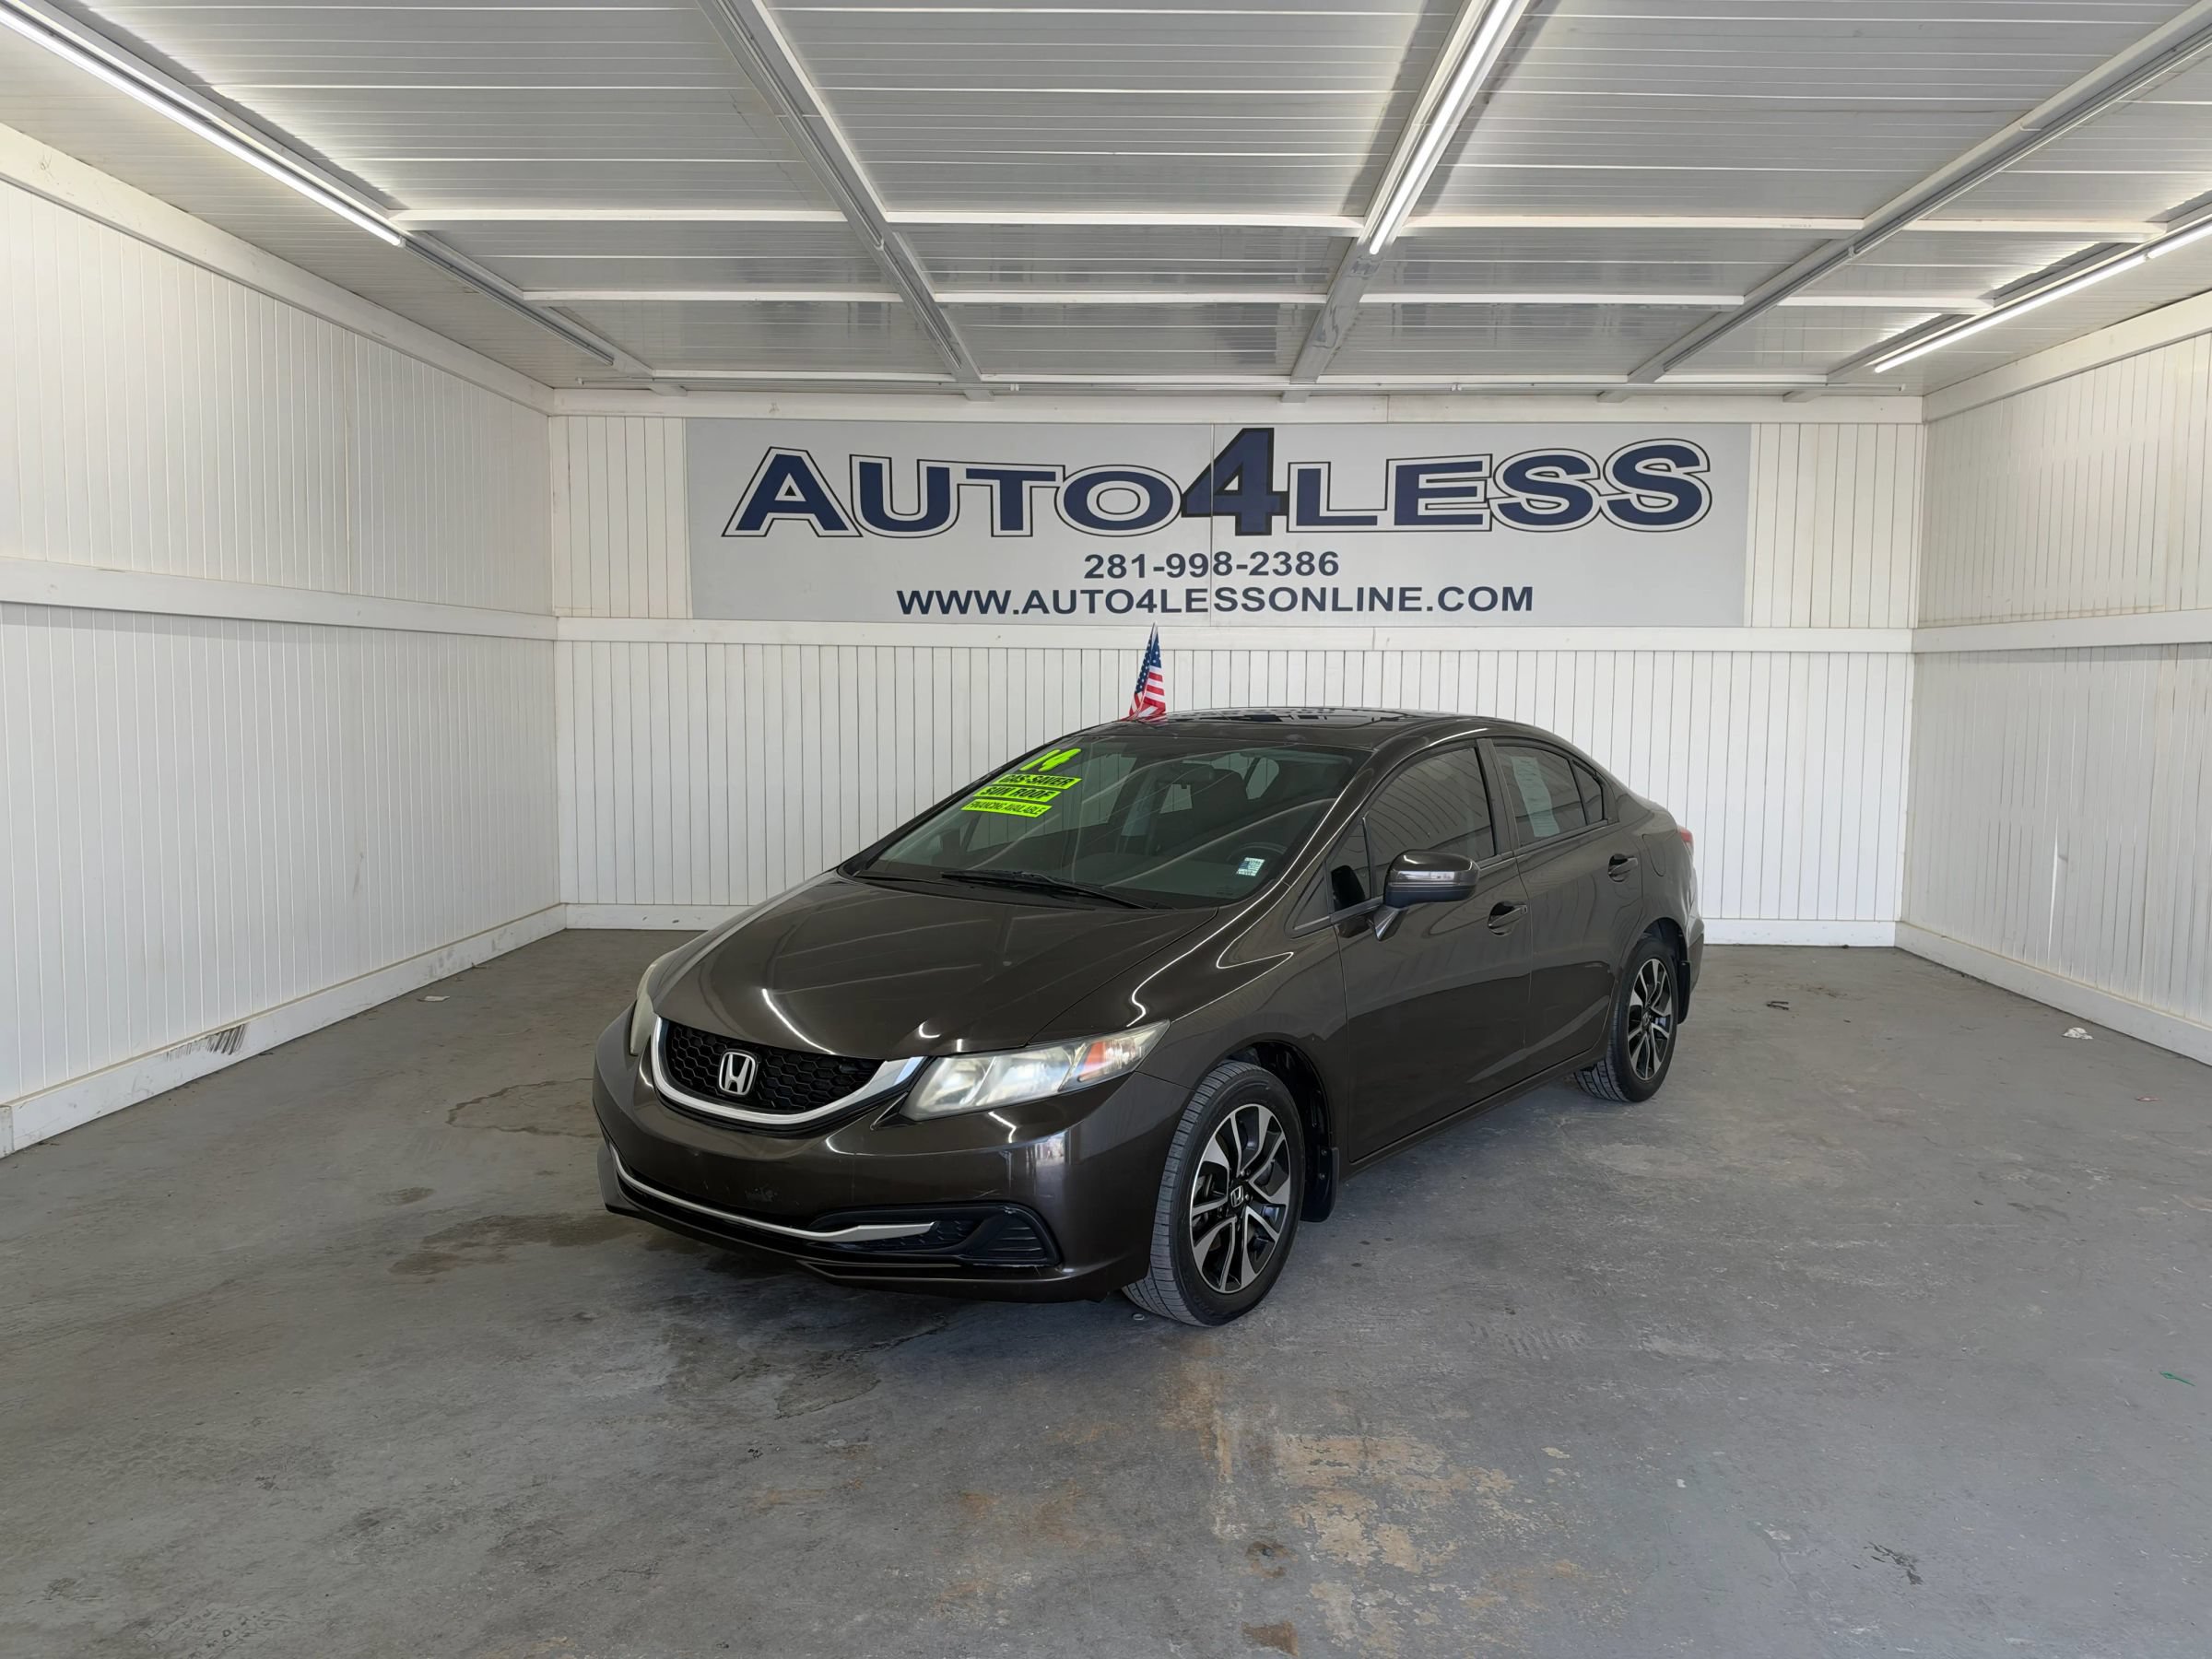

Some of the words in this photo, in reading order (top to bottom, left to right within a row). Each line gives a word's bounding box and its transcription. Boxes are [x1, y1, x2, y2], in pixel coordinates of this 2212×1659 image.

[1084, 551, 1339, 579] 281-998-2386
[896, 585, 1534, 615] WWW.AUTO4LESSONLINE.COM
[1019, 747, 1082, 772] 14
[981, 786, 1009, 797] SUN
[1010, 788, 1055, 800] ROOF
[969, 801, 1006, 811] FINANCING
[1002, 804, 1047, 816] AVAILABLE
